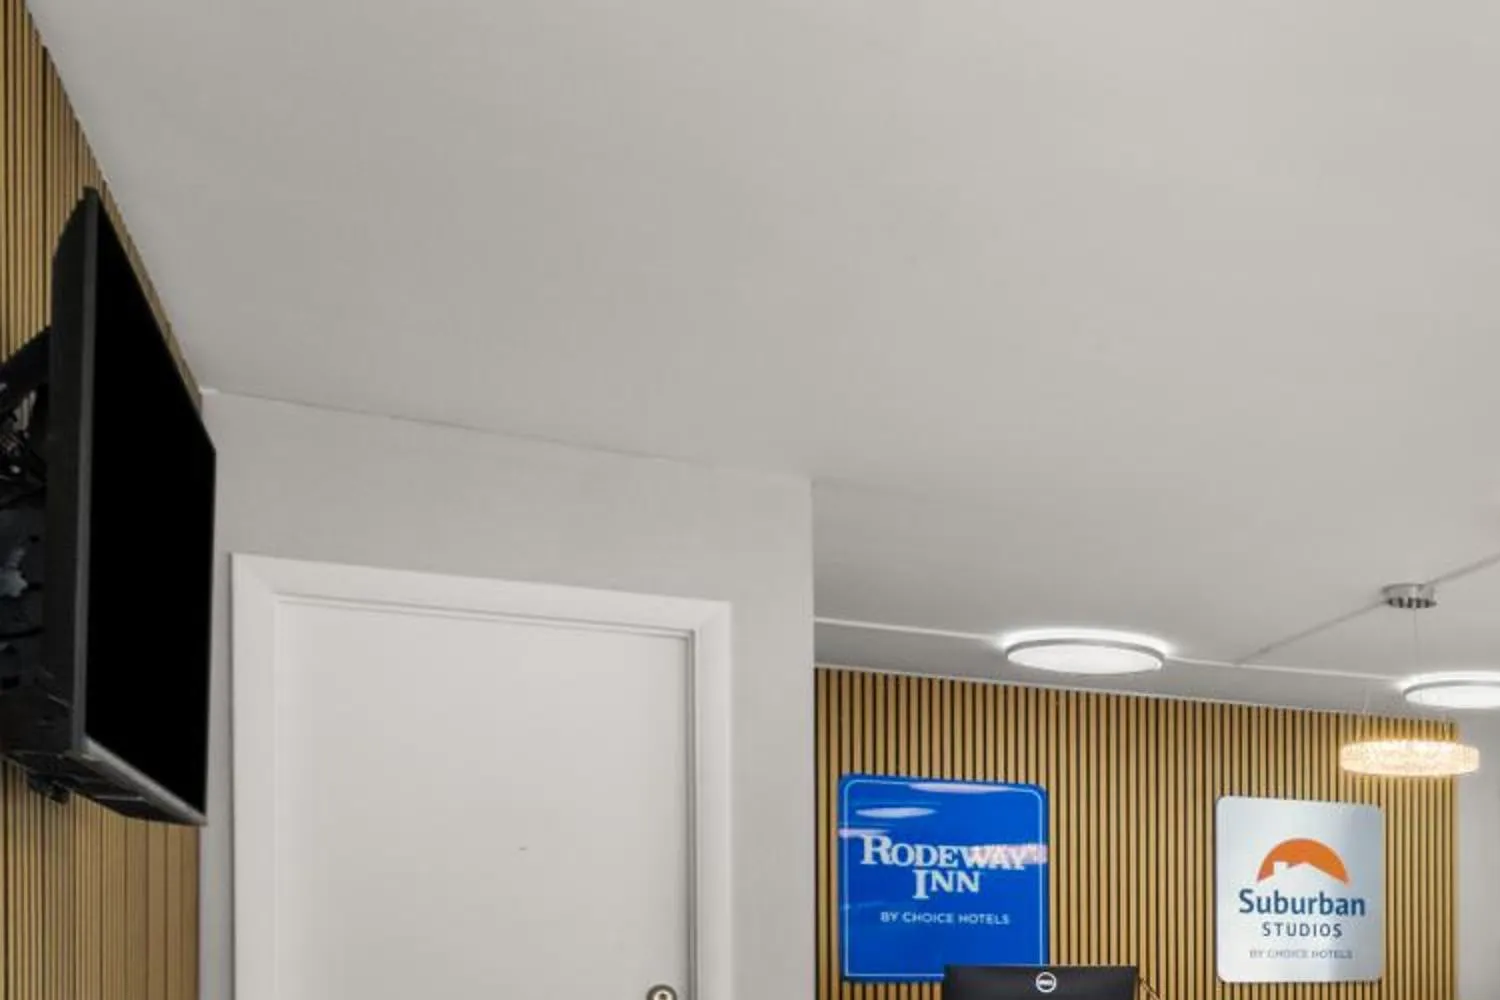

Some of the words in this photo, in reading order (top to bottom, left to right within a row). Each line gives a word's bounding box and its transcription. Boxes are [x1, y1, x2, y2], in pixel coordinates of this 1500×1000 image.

[860, 834, 1025, 870] RODEWAY
[911, 869, 981, 899] INN
[1239, 888, 1366, 917] Suburban
[880, 911, 898, 923] BY
[902, 911, 953, 924] CHOICE
[958, 913, 1010, 925] HOTELS
[1262, 921, 1343, 938] STUDIOS
